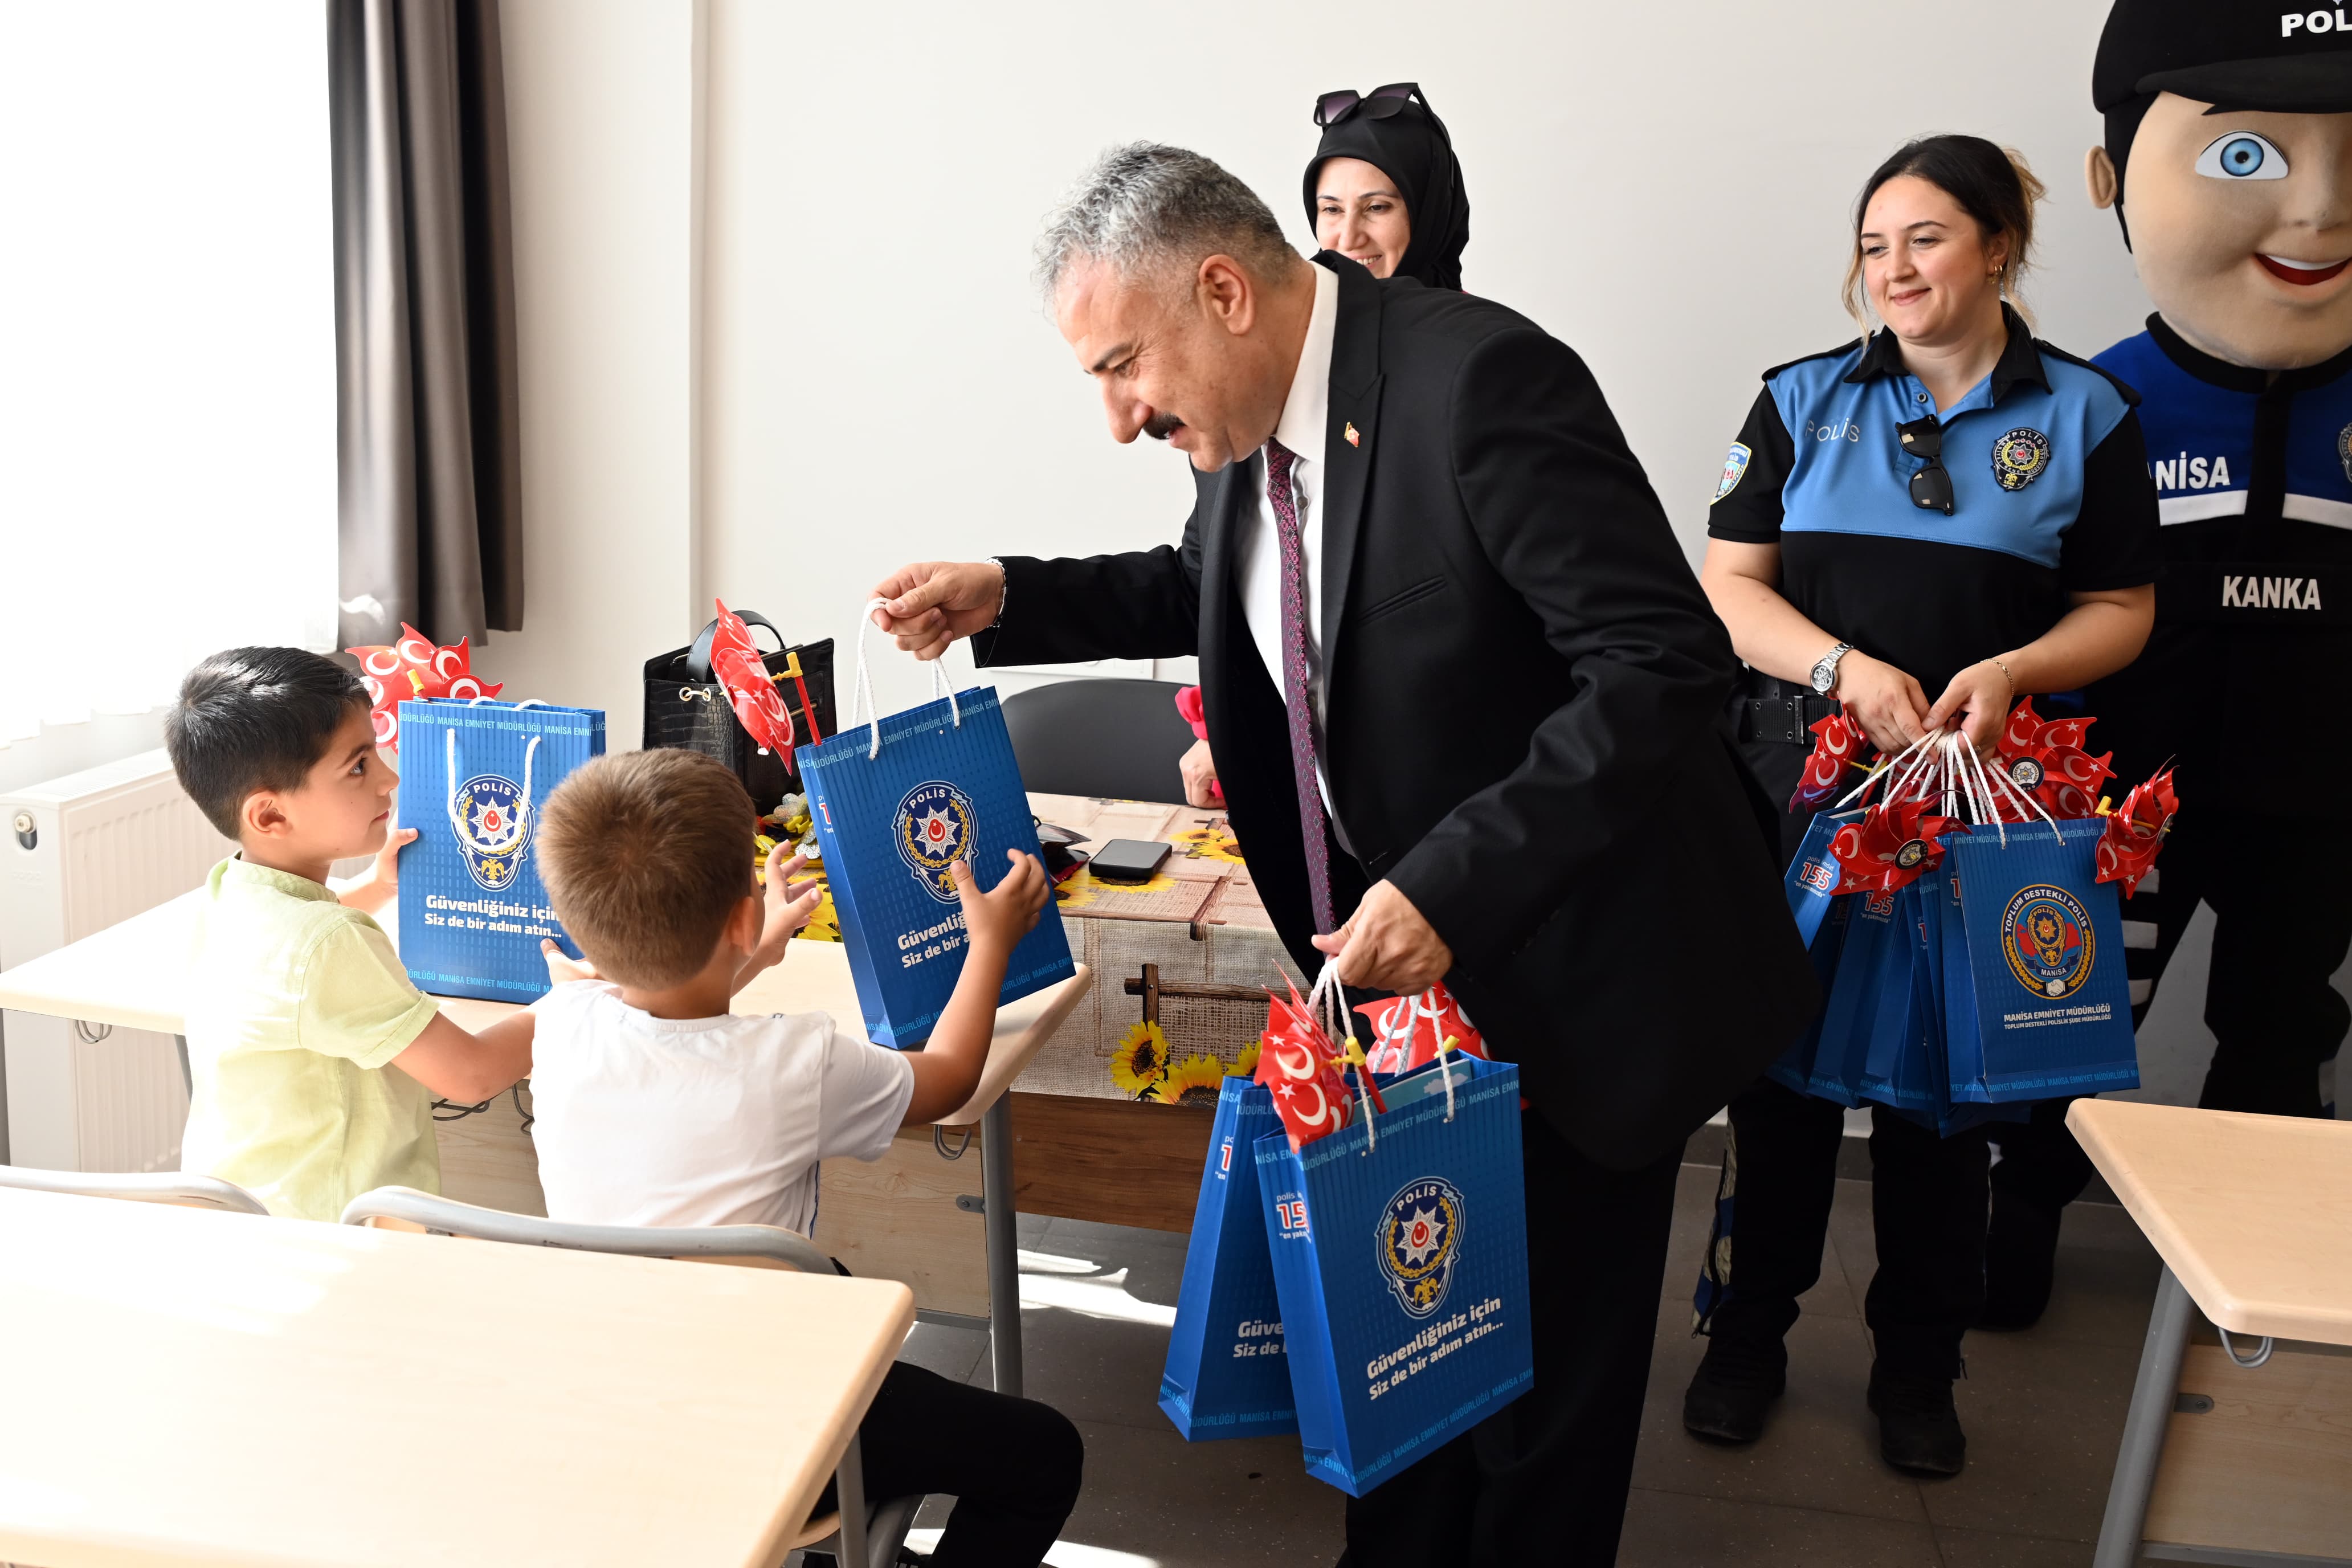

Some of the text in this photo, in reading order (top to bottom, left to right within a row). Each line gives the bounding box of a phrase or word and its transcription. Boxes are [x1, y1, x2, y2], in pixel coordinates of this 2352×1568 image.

[2281, 9, 2352, 37] POL
[1805, 417, 1860, 442] POLİS
[2012, 430, 2043, 444] POLİS
[2222, 575, 2322, 610] KANKA
[438, 715, 463, 727] MANİSA
[465, 718, 495, 730] EMNİYET
[497, 720, 541, 733] MÜDÜRLÜĞÜ
[544, 724, 571, 736] MANİSA
[884, 728, 913, 745] EMNİYET
[473, 783, 512, 797] POLİS
[909, 788, 946, 809] POLİS
[2012, 832, 2034, 842] MANİSA
[2061, 828, 2098, 838] MÜDÜRLÜĞÜ
[1800, 861, 1833, 891] 155
[426, 895, 529, 918] Güvenliğiniz
[2006, 889, 2087, 932] TOPLUM DESTEKLİ POLİS
[2033, 908, 2053, 916] POLİS
[424, 913, 562, 938] Siz de bir adım atın...
[901, 953, 923, 968] Siz
[924, 945, 941, 959] de
[942, 936, 961, 952] bir
[1032, 962, 1058, 979] MANİSA
[2041, 967, 2067, 977] MANİSA
[439, 974, 464, 984] MANİSA
[466, 976, 495, 987] EMNİYET
[497, 979, 540, 993] MÜDÜRLÜĞÜ
[2004, 1003, 2110, 1022] MANİSA EMNİYET MÜDÜRLÜĞÜ
[2025, 1019, 2047, 1028] DESTEKLİ
[2048, 1017, 2068, 1026] POLİSLİK
[2012, 1078, 2045, 1090] MÜDÜRLÜĞÜ
[2047, 1076, 2069, 1087] MANİSA
[2069, 1073, 2093, 1085] EMNİYET
[2094, 1070, 2129, 1082] MÜDÜRLÜĞÜ
[1381, 1117, 1414, 1138] EMNİYET
[1469, 1088, 1500, 1105] MANİSA
[1276, 1191, 1295, 1203] polis
[1396, 1186, 1437, 1211] POLİS
[1233, 1342, 1256, 1357] Siz
[1260, 1341, 1279, 1355] de
[1367, 1297, 1501, 1380] Güvenliğiniz için
[1369, 1322, 1504, 1400] Siz de bir adım atın...
[1240, 1411, 1269, 1423] MANİSA
[1394, 1436, 1420, 1459] MANİSA
[1421, 1417, 1449, 1442] EMNİYET
[1449, 1390, 1490, 1423] MÜDÜRLÜĞÜ
[1492, 1377, 1518, 1396] MANİSA
